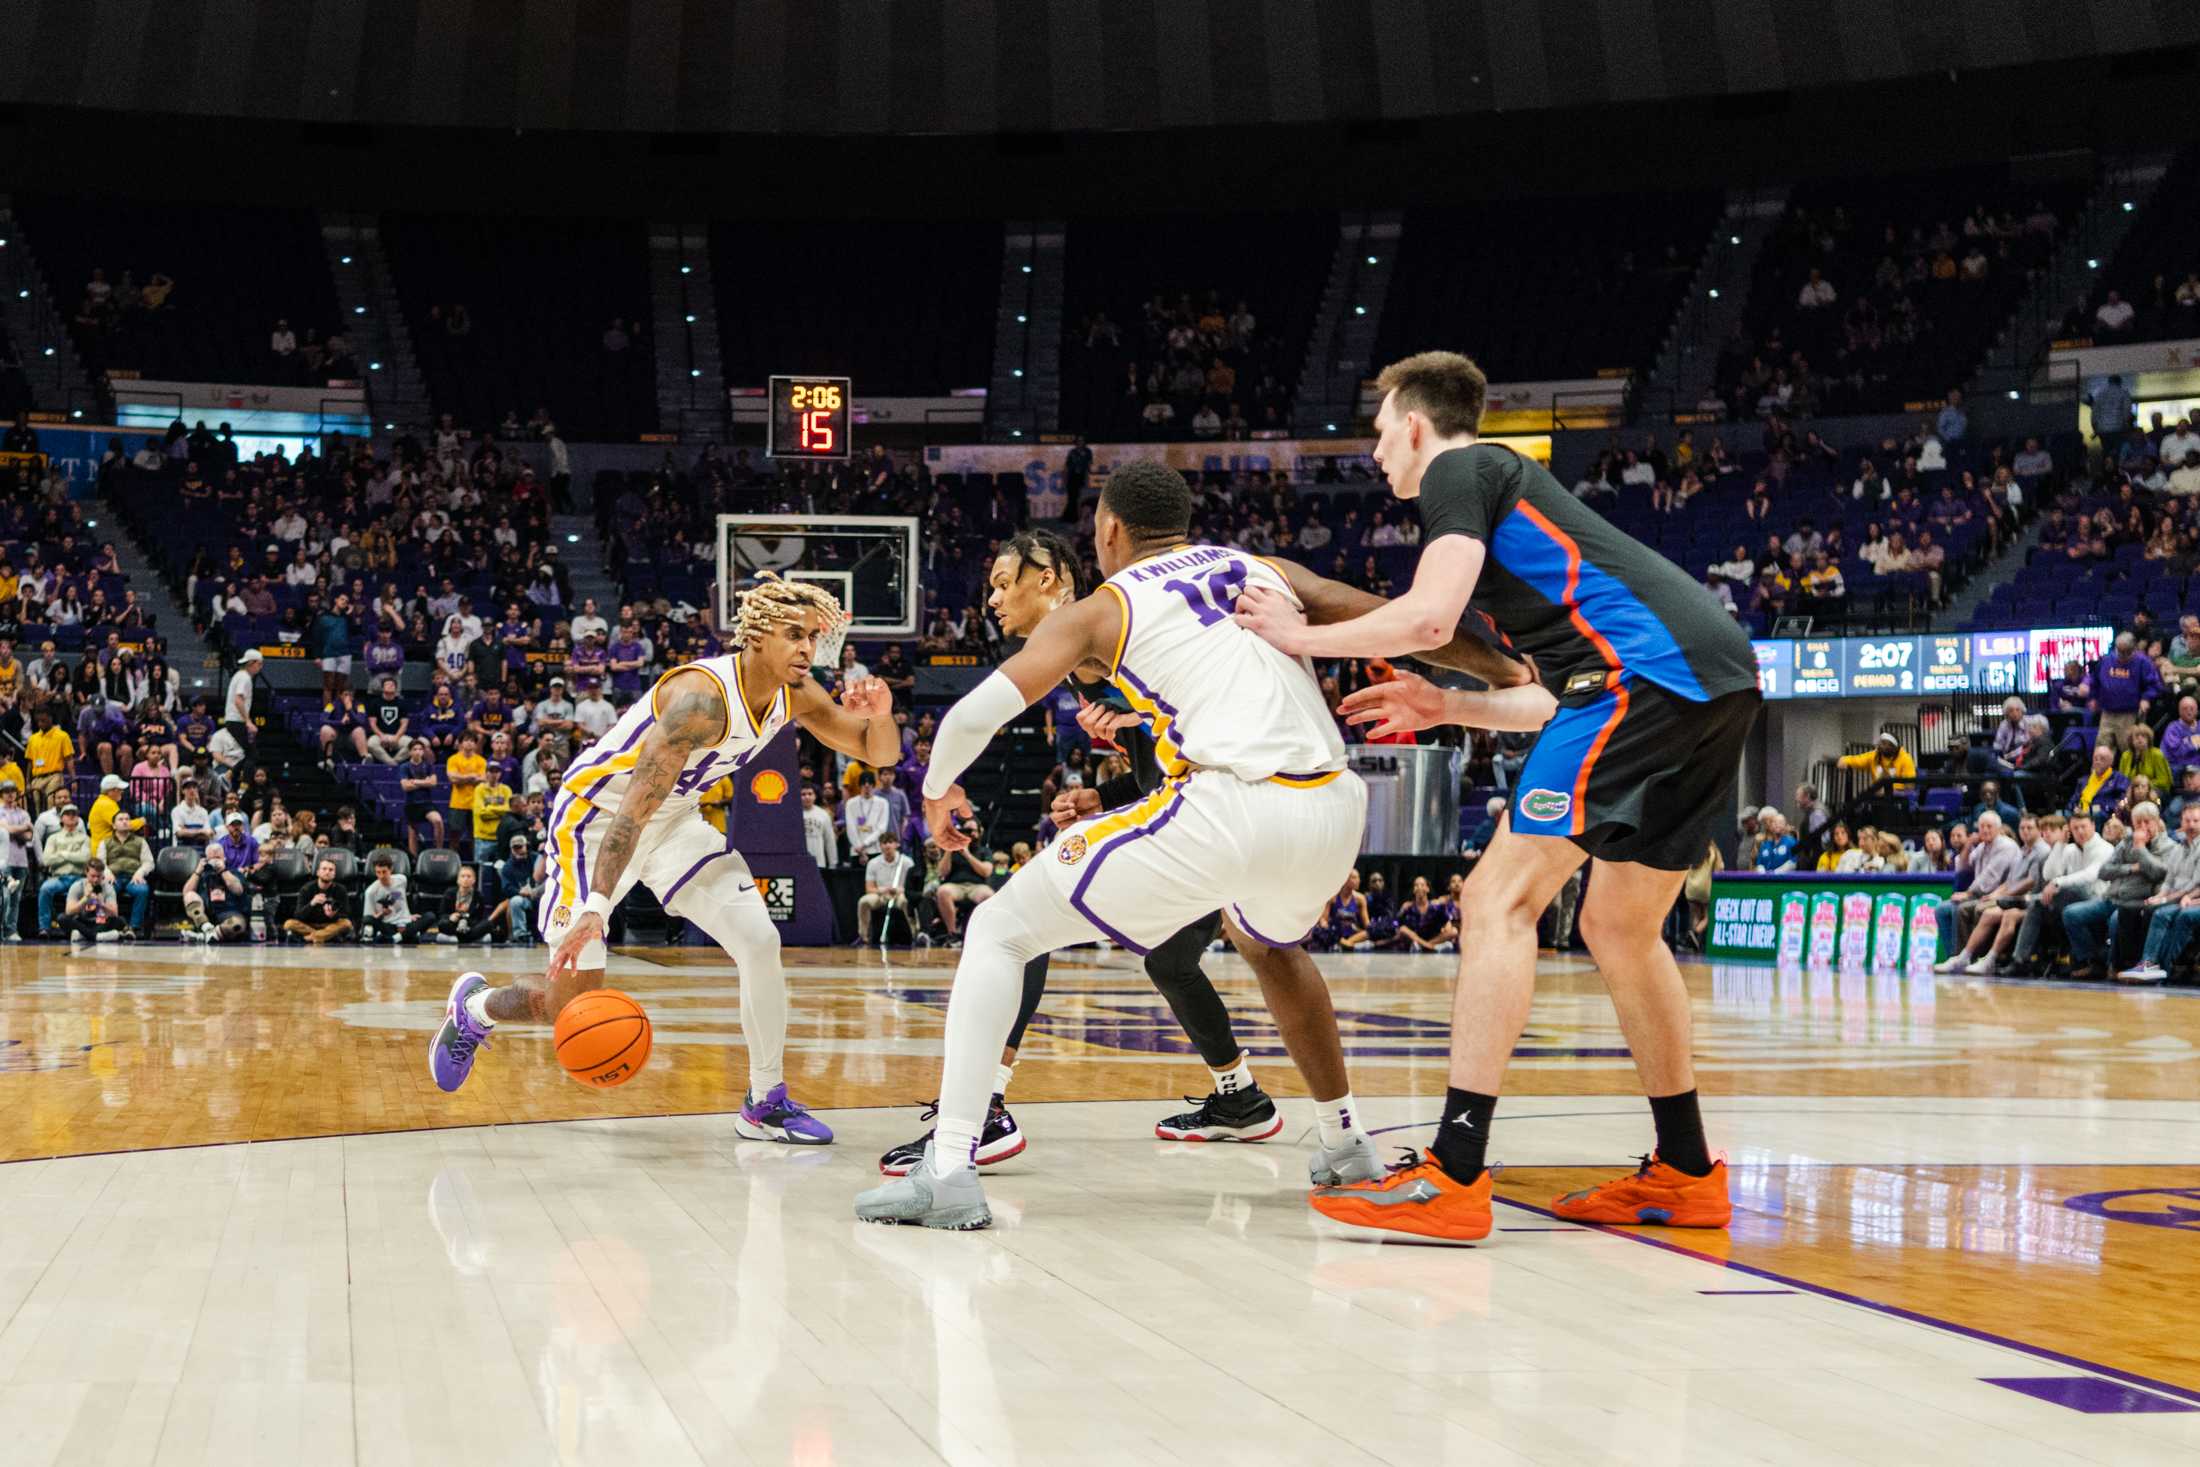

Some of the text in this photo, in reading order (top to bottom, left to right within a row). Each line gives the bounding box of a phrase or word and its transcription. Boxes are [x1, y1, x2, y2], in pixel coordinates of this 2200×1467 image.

[791, 385, 841, 409] 2:06
[802, 411, 833, 449] 15
[1859, 642, 1914, 668] 2:07
[1937, 647, 1957, 665] 10
[1979, 637, 2025, 656] LSU
[1853, 670, 1914, 690] PERIOD 2
[1715, 898, 1740, 921] CHECK
[1740, 899, 1756, 922] OUT
[1756, 899, 1773, 922] OUR
[1712, 922, 1747, 946] ALL-STAR
[592, 1062, 630, 1085] LSU
